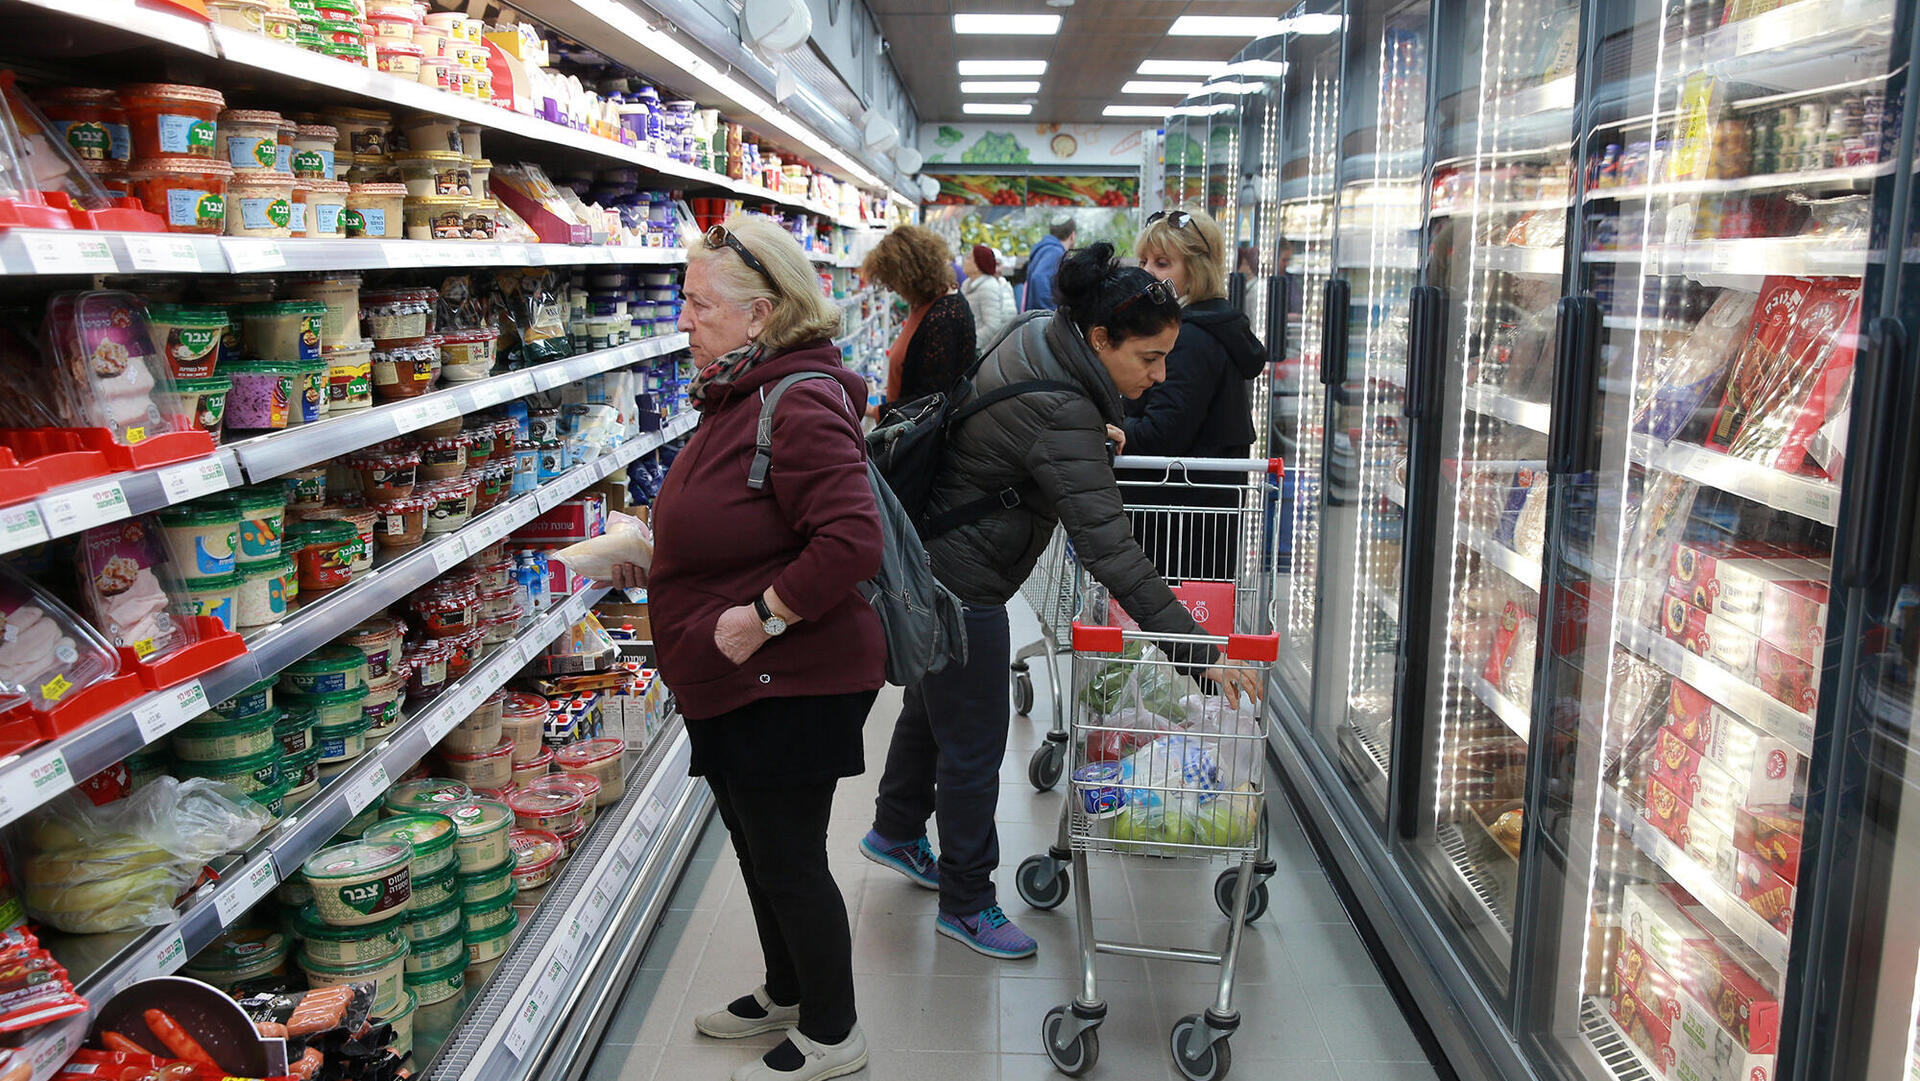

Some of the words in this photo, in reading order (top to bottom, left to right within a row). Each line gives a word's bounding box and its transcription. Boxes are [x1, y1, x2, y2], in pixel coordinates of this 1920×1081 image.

[72, 131, 103, 142] צבר
[195, 128, 214, 140] צבר
[260, 144, 275, 154] צבר
[298, 156, 320, 166] צבר
[203, 200, 223, 212] צבר
[272, 204, 289, 214] צבר
[184, 332, 211, 342] צבר
[350, 384, 367, 393] צבר
[299, 485, 317, 494] צבר
[551, 522, 575, 530] שמנת
[297, 676, 314, 684] צבר
[256, 766, 273, 778] צבר
[388, 870, 408, 886] חומוס
[343, 883, 379, 901] צבר
